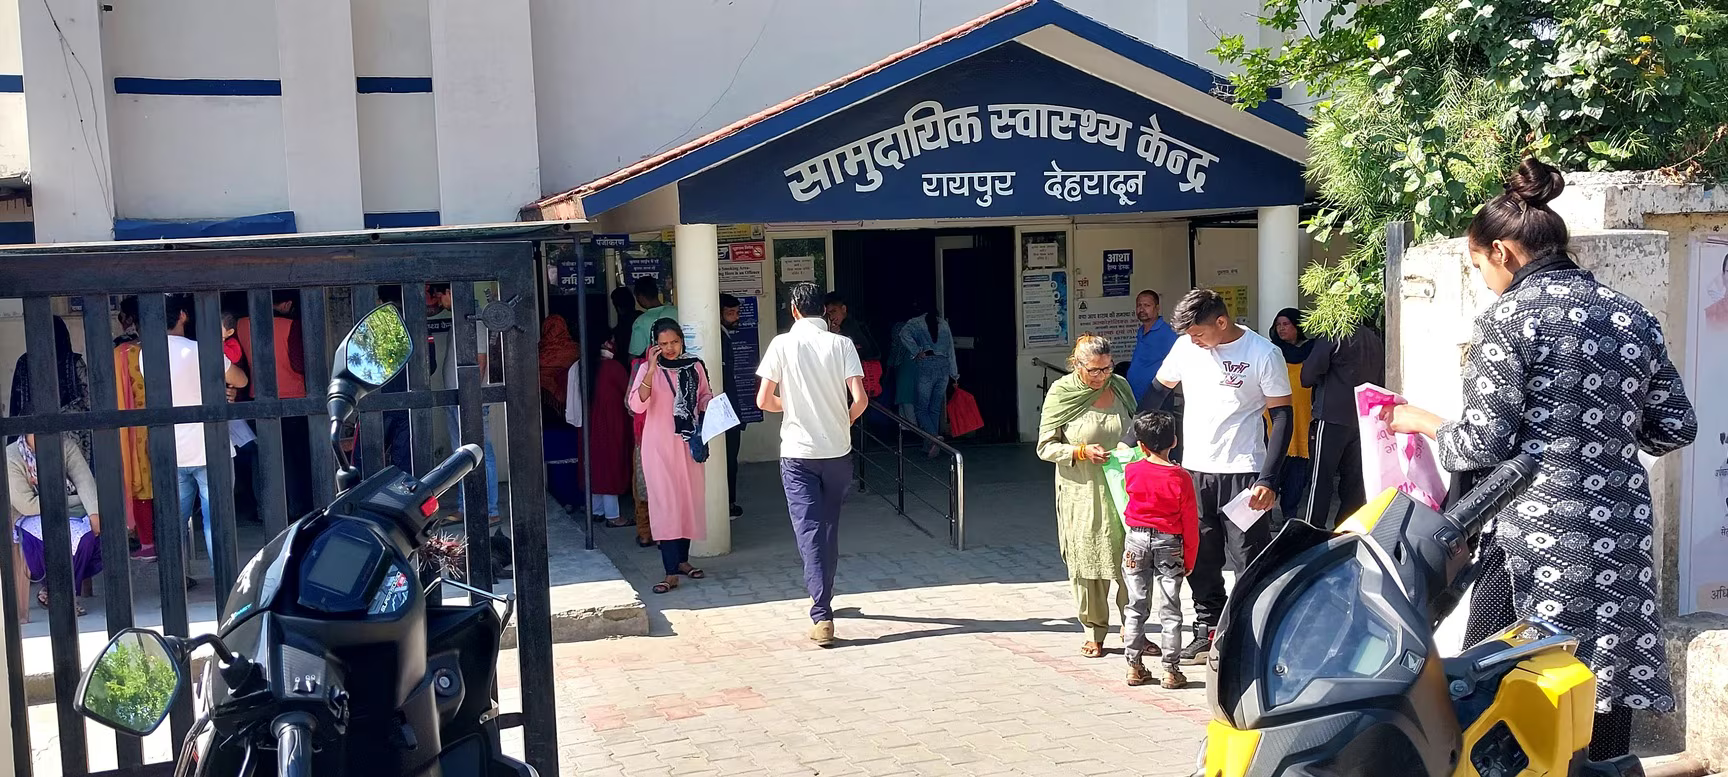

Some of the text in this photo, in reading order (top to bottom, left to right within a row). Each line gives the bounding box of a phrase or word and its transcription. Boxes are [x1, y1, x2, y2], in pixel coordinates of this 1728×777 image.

[783, 101, 1220, 202] सामुदायिक स्वास्थ्य केन्द्र
[921, 159, 1147, 207] रायपुर देहरादून
[596, 237, 625, 246] पंजीकरण
[1107, 253, 1130, 263] आशा
[1463, 477, 1508, 511] HONDA
